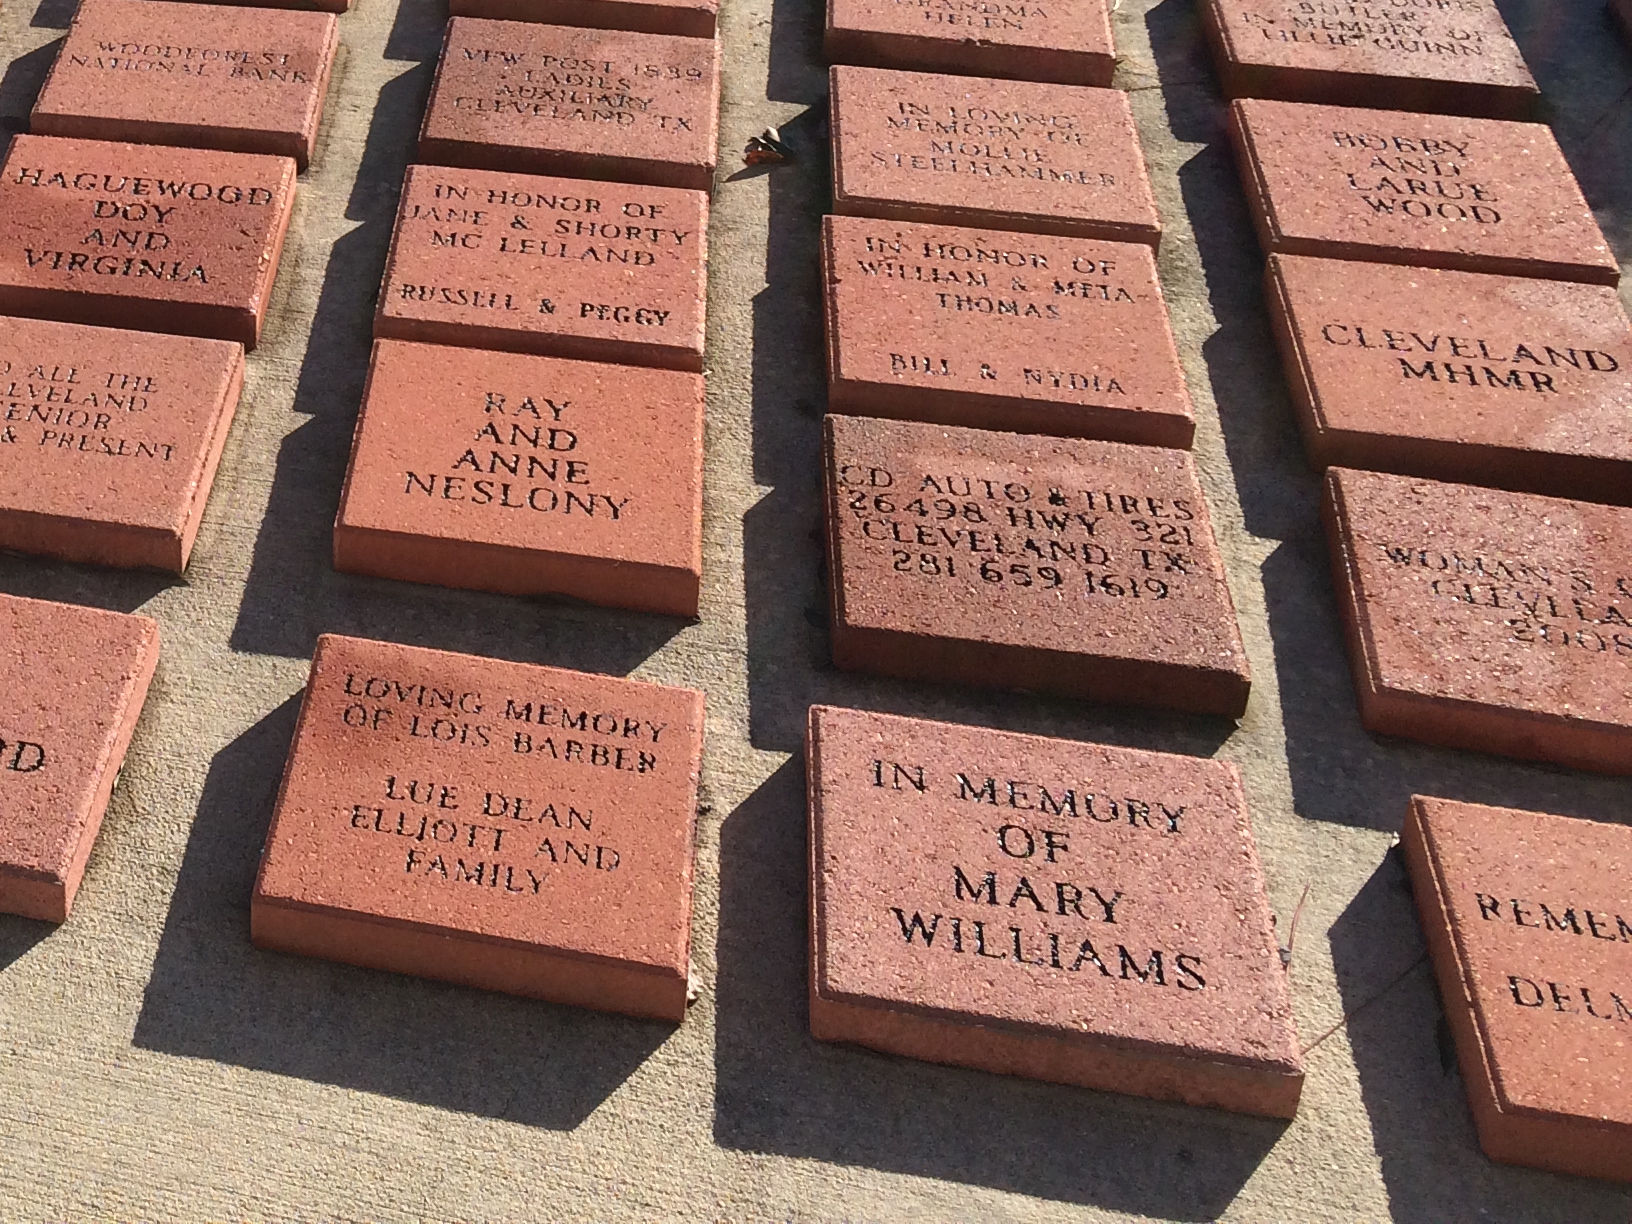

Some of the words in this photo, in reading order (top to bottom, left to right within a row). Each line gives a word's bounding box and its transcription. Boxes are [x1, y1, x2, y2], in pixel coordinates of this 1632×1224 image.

[69, 55, 210, 75] NATIONAL
[230, 66, 313, 84] BANK
[99, 41, 290, 66] WOODFOREST
[463, 48, 525, 65] VFW
[543, 55, 617, 73] POST
[496, 86, 654, 110] AUXILIARY
[524, 70, 631, 90] LADIES
[455, 96, 635, 125] CLEVELAND
[654, 115, 693, 131] TX
[1332, 131, 1469, 158] BOBBY
[1368, 155, 1461, 176] AND
[435, 185, 468, 200] IN
[487, 189, 602, 214] HONOR
[622, 203, 666, 219] OF
[1347, 174, 1499, 203] LARUE
[93, 200, 177, 224] DOY
[403, 204, 490, 226] JANE
[510, 216, 530, 230] &
[555, 219, 691, 246] SHORTY
[1362, 195, 1501, 224] WOOD
[80, 228, 169, 251] AND
[431, 230, 482, 249] MC
[499, 238, 656, 266] LELLAND
[24, 248, 209, 284] VIRGINIA
[400, 284, 519, 311] RUSSELL
[579, 302, 670, 326] PEGGY
[1321, 324, 1619, 373] CLEVELAND
[27, 364, 82, 384] ALL
[106, 373, 159, 393] THE
[1397, 357, 1558, 393] MHMR
[483, 391, 572, 422] RAY
[38, 429, 178, 462] PRESENT
[473, 421, 579, 452] AND
[451, 447, 591, 485] ANNE
[404, 471, 630, 520] NESLONY
[839, 465, 893, 489] CD
[919, 474, 1032, 502] AUTO
[1048, 486, 1069, 506] &
[1077, 489, 1194, 521] TIRES
[848, 489, 988, 524] 26498
[1005, 506, 1103, 536] HWY
[1131, 520, 1194, 546] 321
[863, 519, 1111, 566] CLEVELAND
[1133, 548, 1197, 575] TX
[893, 549, 956, 577] 281
[980, 560, 1063, 589] 659
[1085, 570, 1169, 601] 1619
[343, 674, 482, 714] LOVING
[504, 699, 667, 743] MEMORY
[343, 705, 392, 730] OF
[410, 720, 491, 747] LOIS
[386, 777, 458, 809] LUE
[484, 793, 592, 831] DEAN
[873, 760, 927, 794] IN
[956, 774, 1185, 833] MEMORY
[350, 805, 507, 851] ELLIOTT
[535, 838, 621, 871] AND
[997, 825, 1070, 862] OF
[405, 849, 552, 894] FAMILY
[953, 865, 1125, 923] MARY
[890, 907, 1205, 990] WILLIAMS
